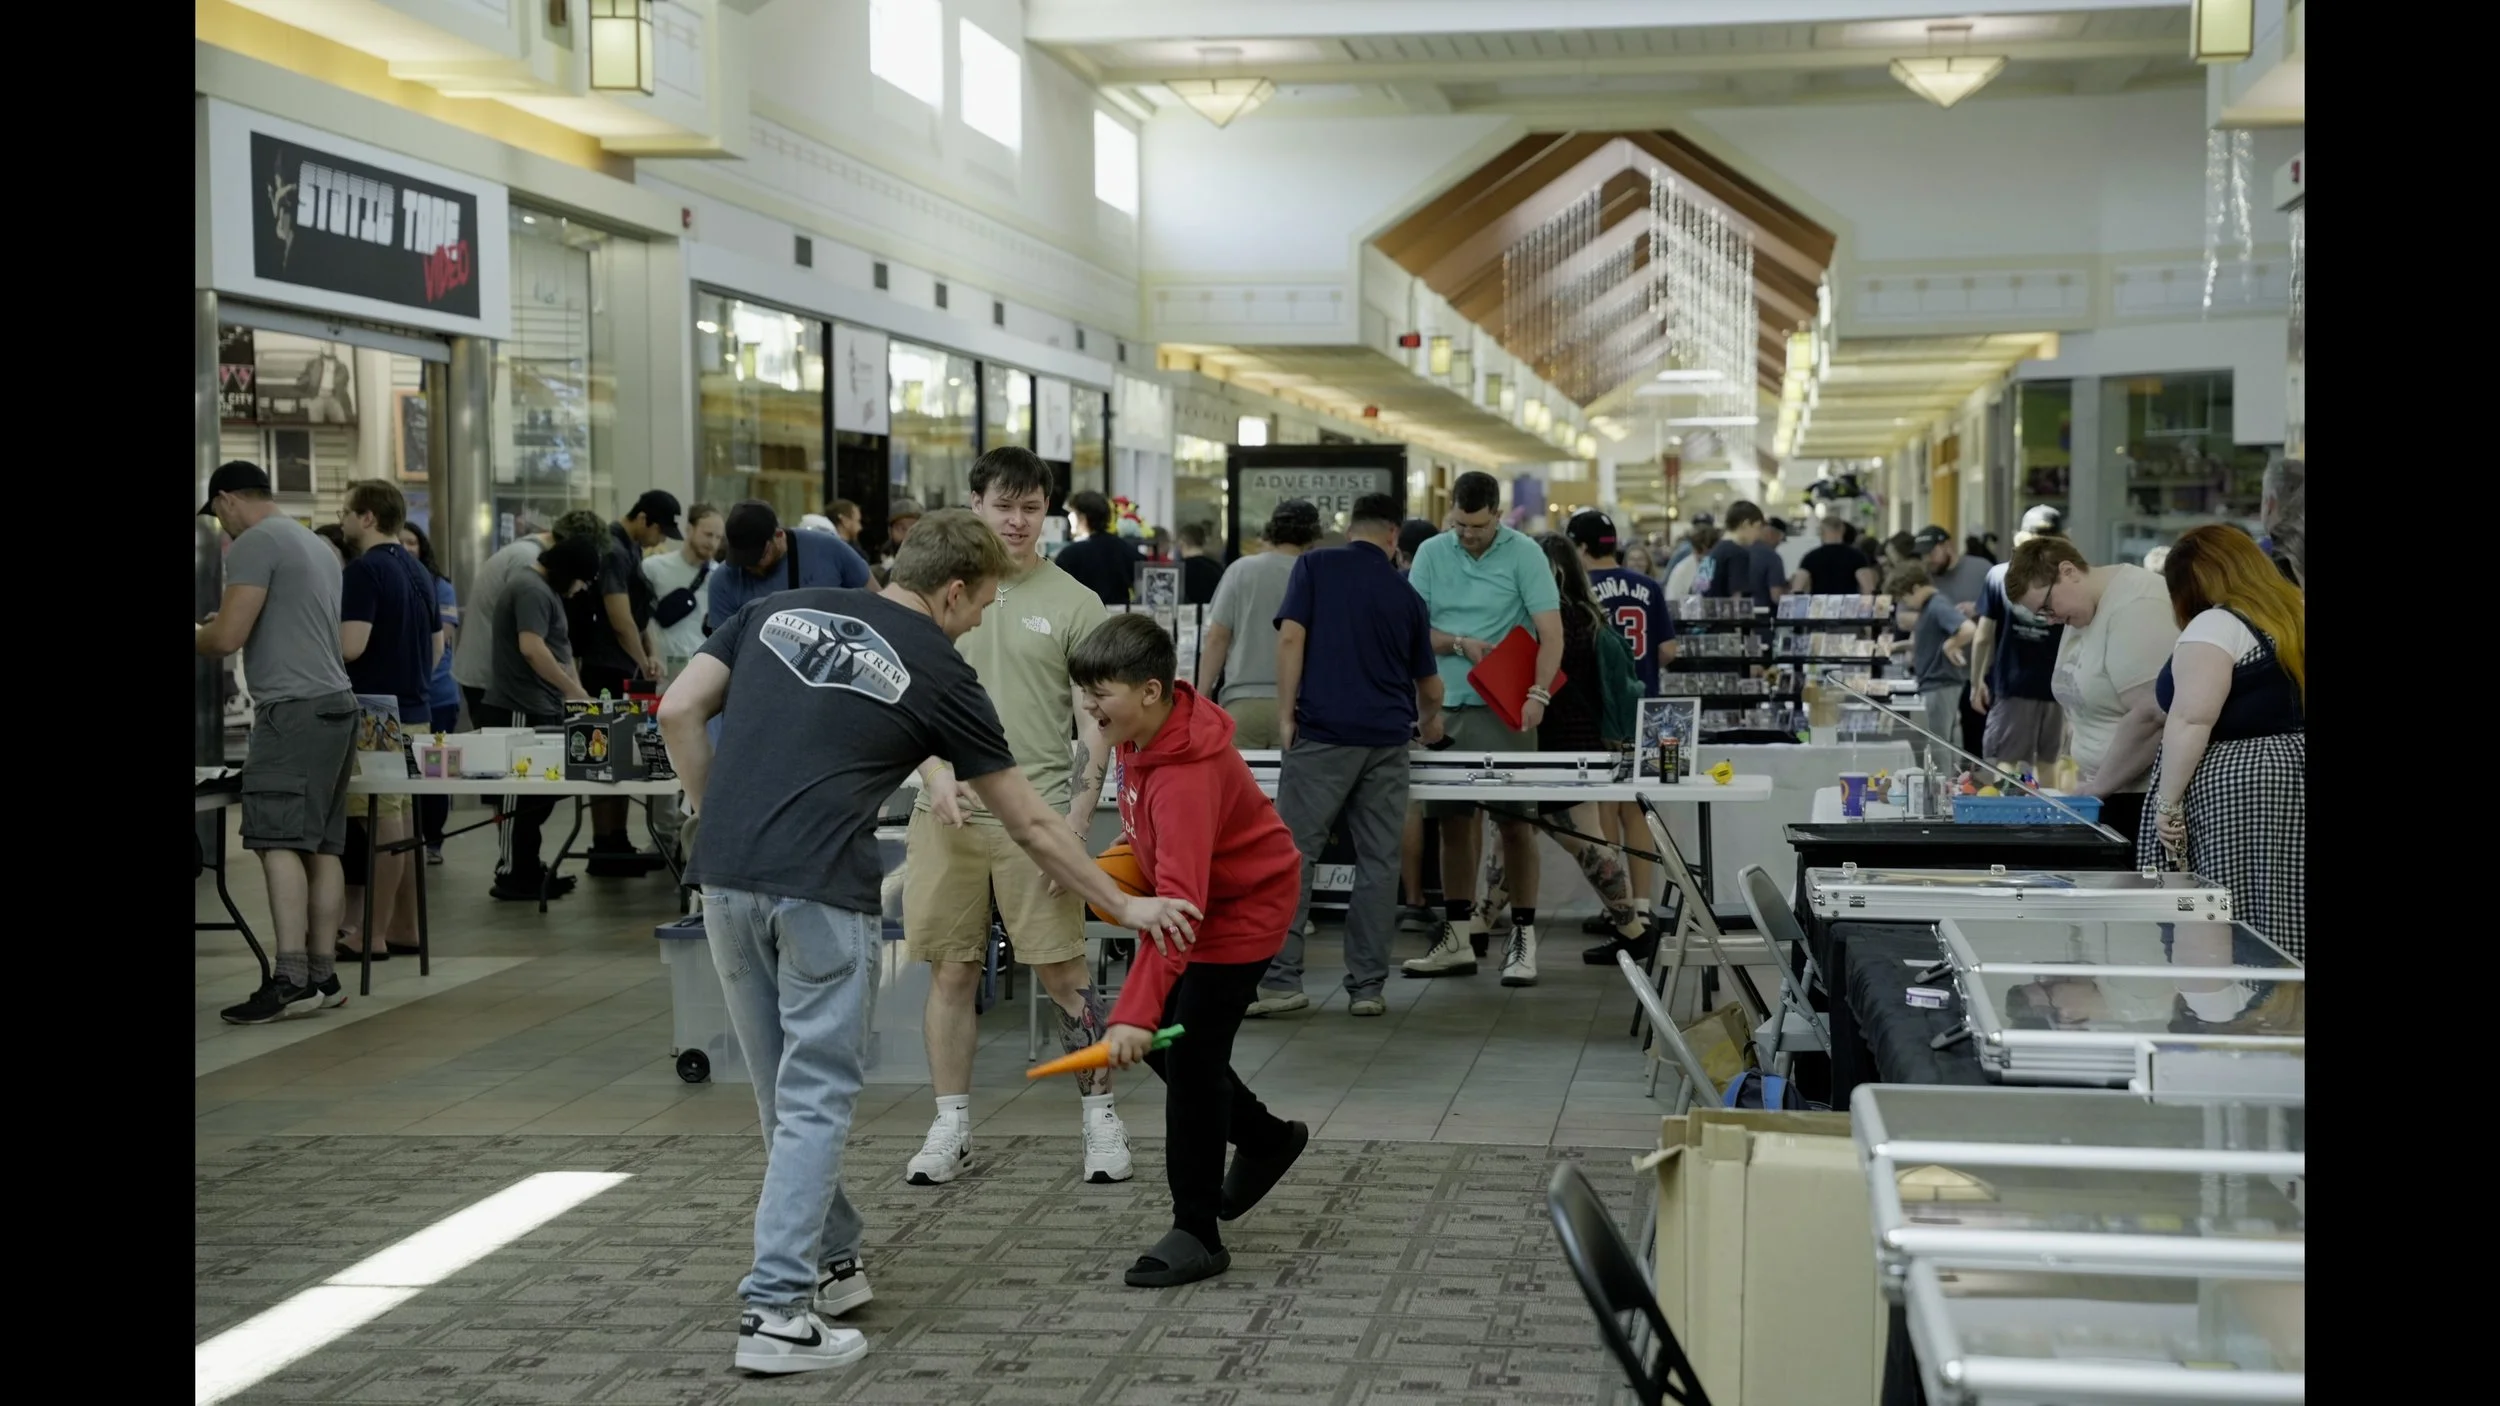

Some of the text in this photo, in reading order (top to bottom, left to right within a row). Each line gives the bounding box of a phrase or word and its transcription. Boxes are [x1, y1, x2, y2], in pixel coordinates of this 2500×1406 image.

[297, 160, 461, 261] STATIC TAPE
[422, 240, 470, 304] VIDEO
[1254, 473, 1375, 490] ADVERTISE
[1592, 577, 1629, 602] CUÑA
[771, 614, 906, 684] SALTY CREW
[864, 667, 889, 689] TAIL
